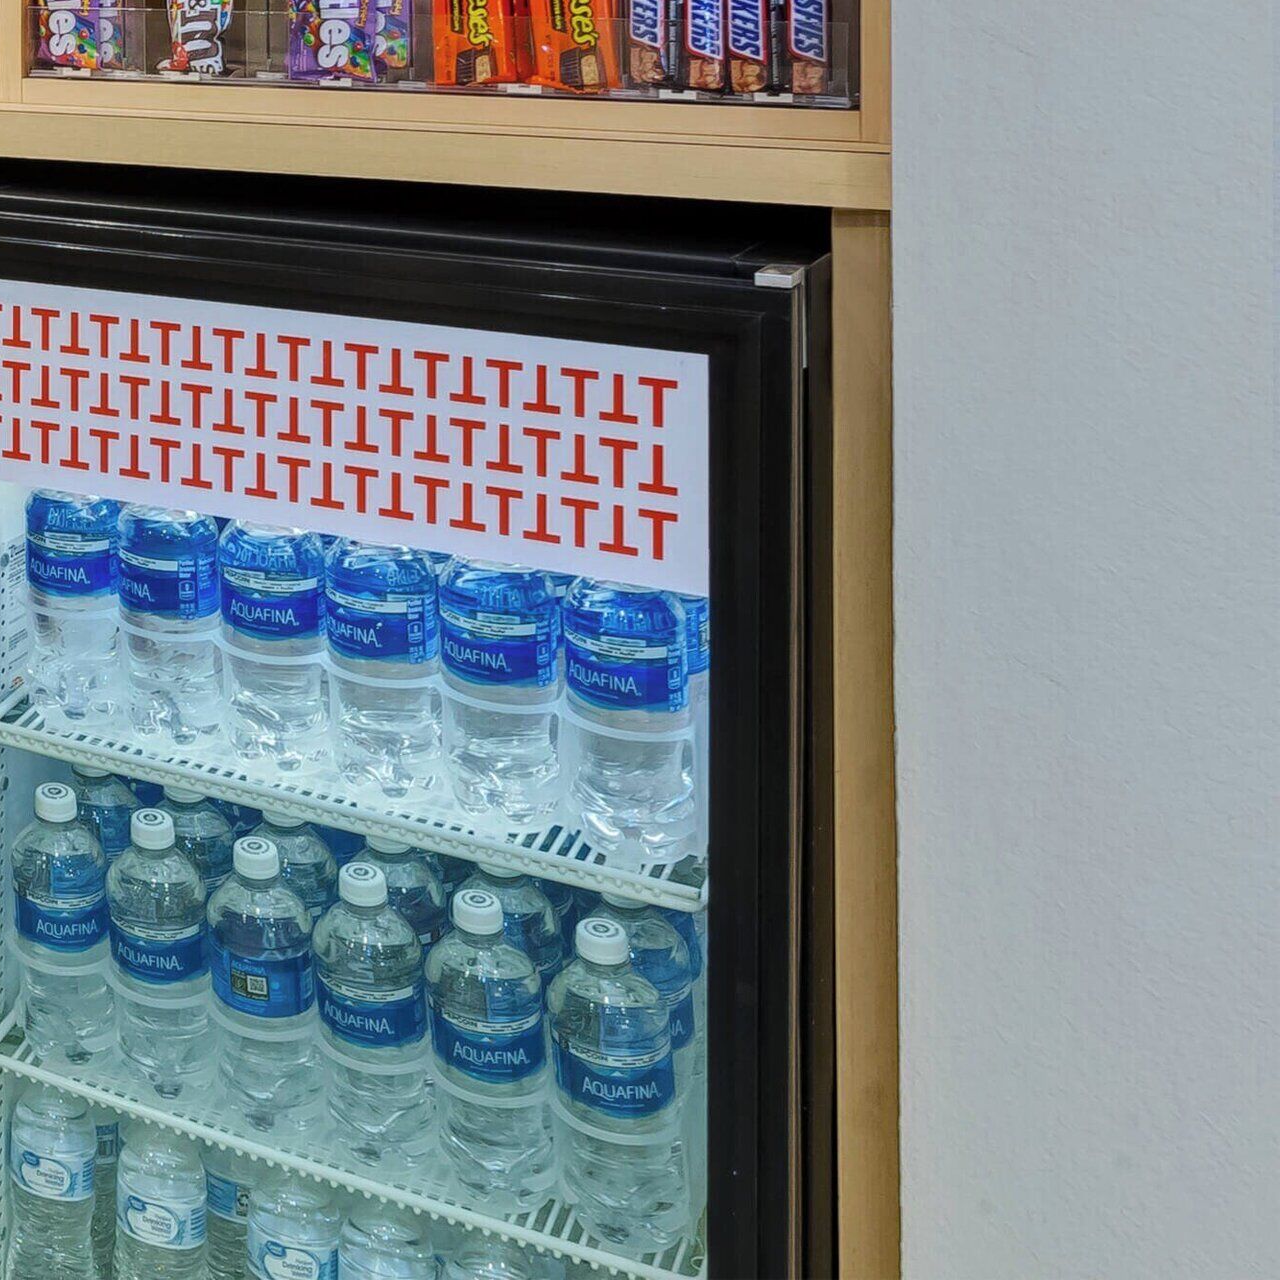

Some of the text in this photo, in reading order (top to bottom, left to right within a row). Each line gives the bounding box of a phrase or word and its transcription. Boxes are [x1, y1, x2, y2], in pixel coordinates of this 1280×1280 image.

[29, 557, 91, 586] AQUAFINA
[121, 576, 154, 602] AFINA
[229, 601, 300, 627] AQUAFINA
[442, 635, 512, 673] AQUAFINA
[568, 658, 642, 696] AQUAFINA
[35, 918, 99, 939] AQUAFINA
[116, 941, 184, 970] AQUAFINA
[323, 1000, 395, 1036] AQUAFINA
[453, 1041, 531, 1066] AQUAFINA
[581, 1075, 662, 1100] AQUAFINA
[141, 1215, 172, 1230] Drinking
